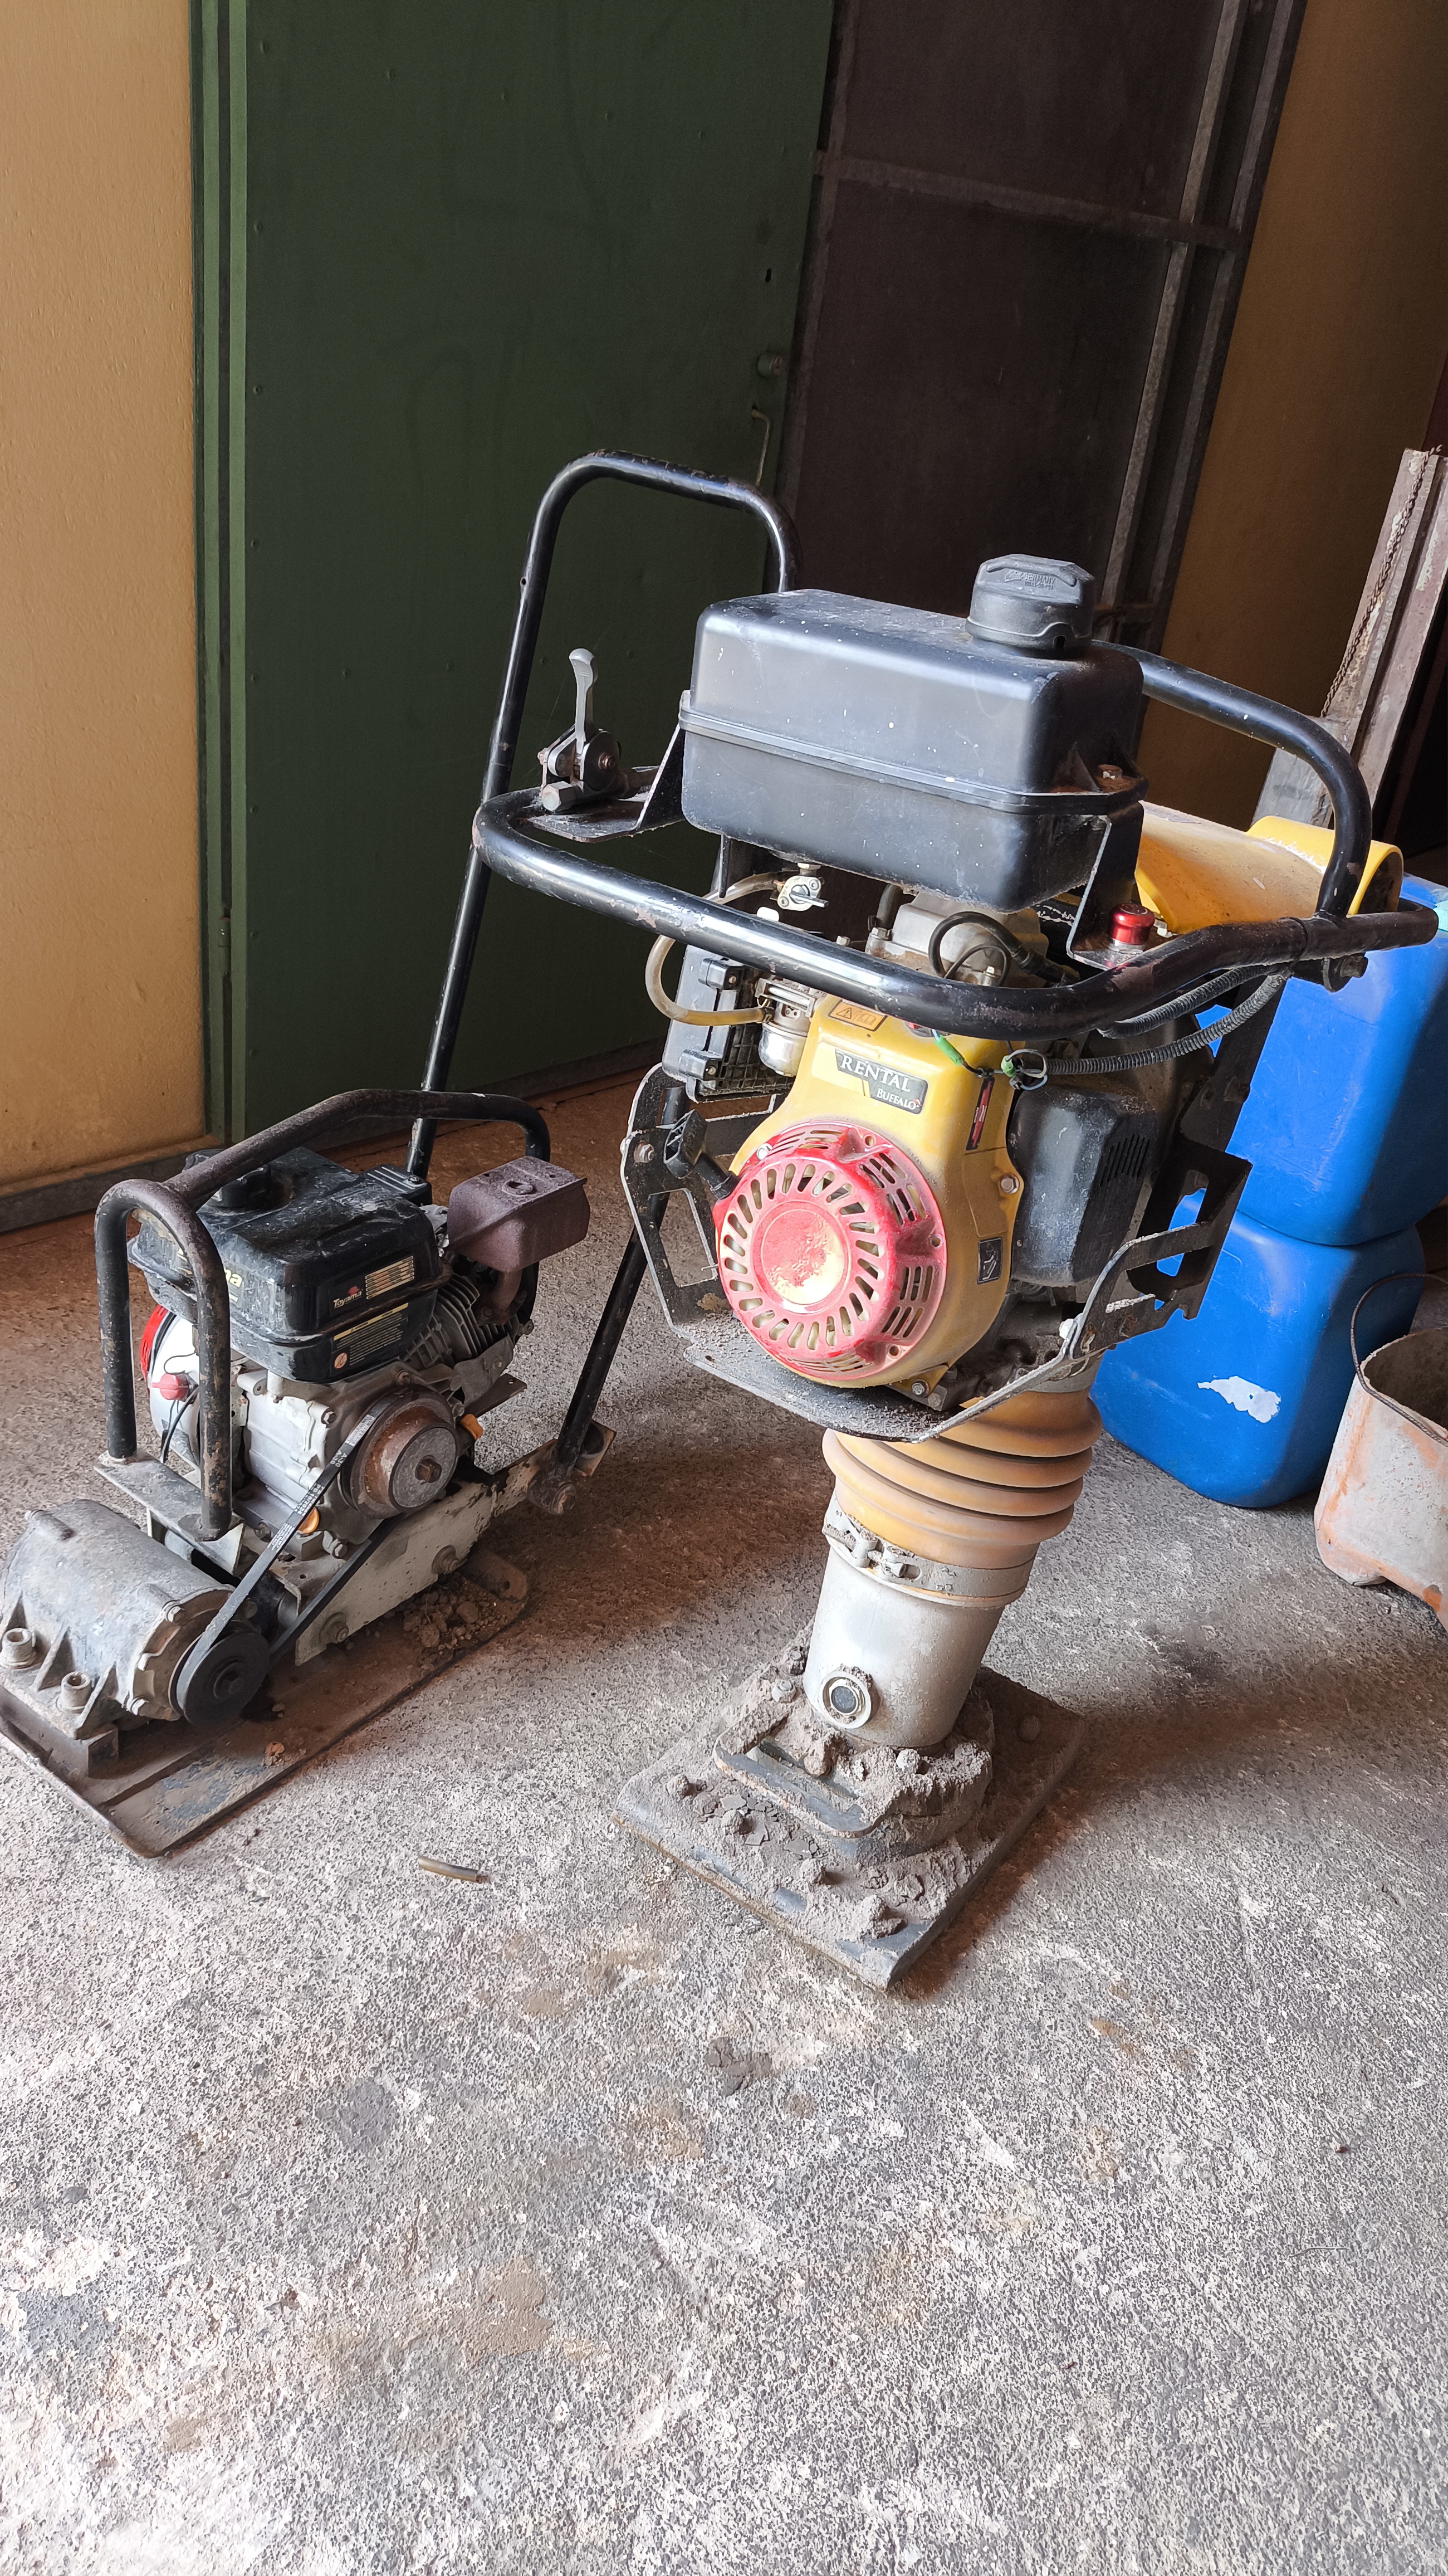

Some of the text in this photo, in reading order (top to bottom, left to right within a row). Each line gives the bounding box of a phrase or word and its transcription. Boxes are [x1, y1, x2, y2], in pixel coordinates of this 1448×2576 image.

[840, 1055, 911, 1092] RENTAL
[876, 1088, 917, 1110] BUFFALO
[334, 1291, 362, 1309] Toyama
[335, 1452, 348, 1467] A30
[297, 1494, 315, 1515] 10/2024
